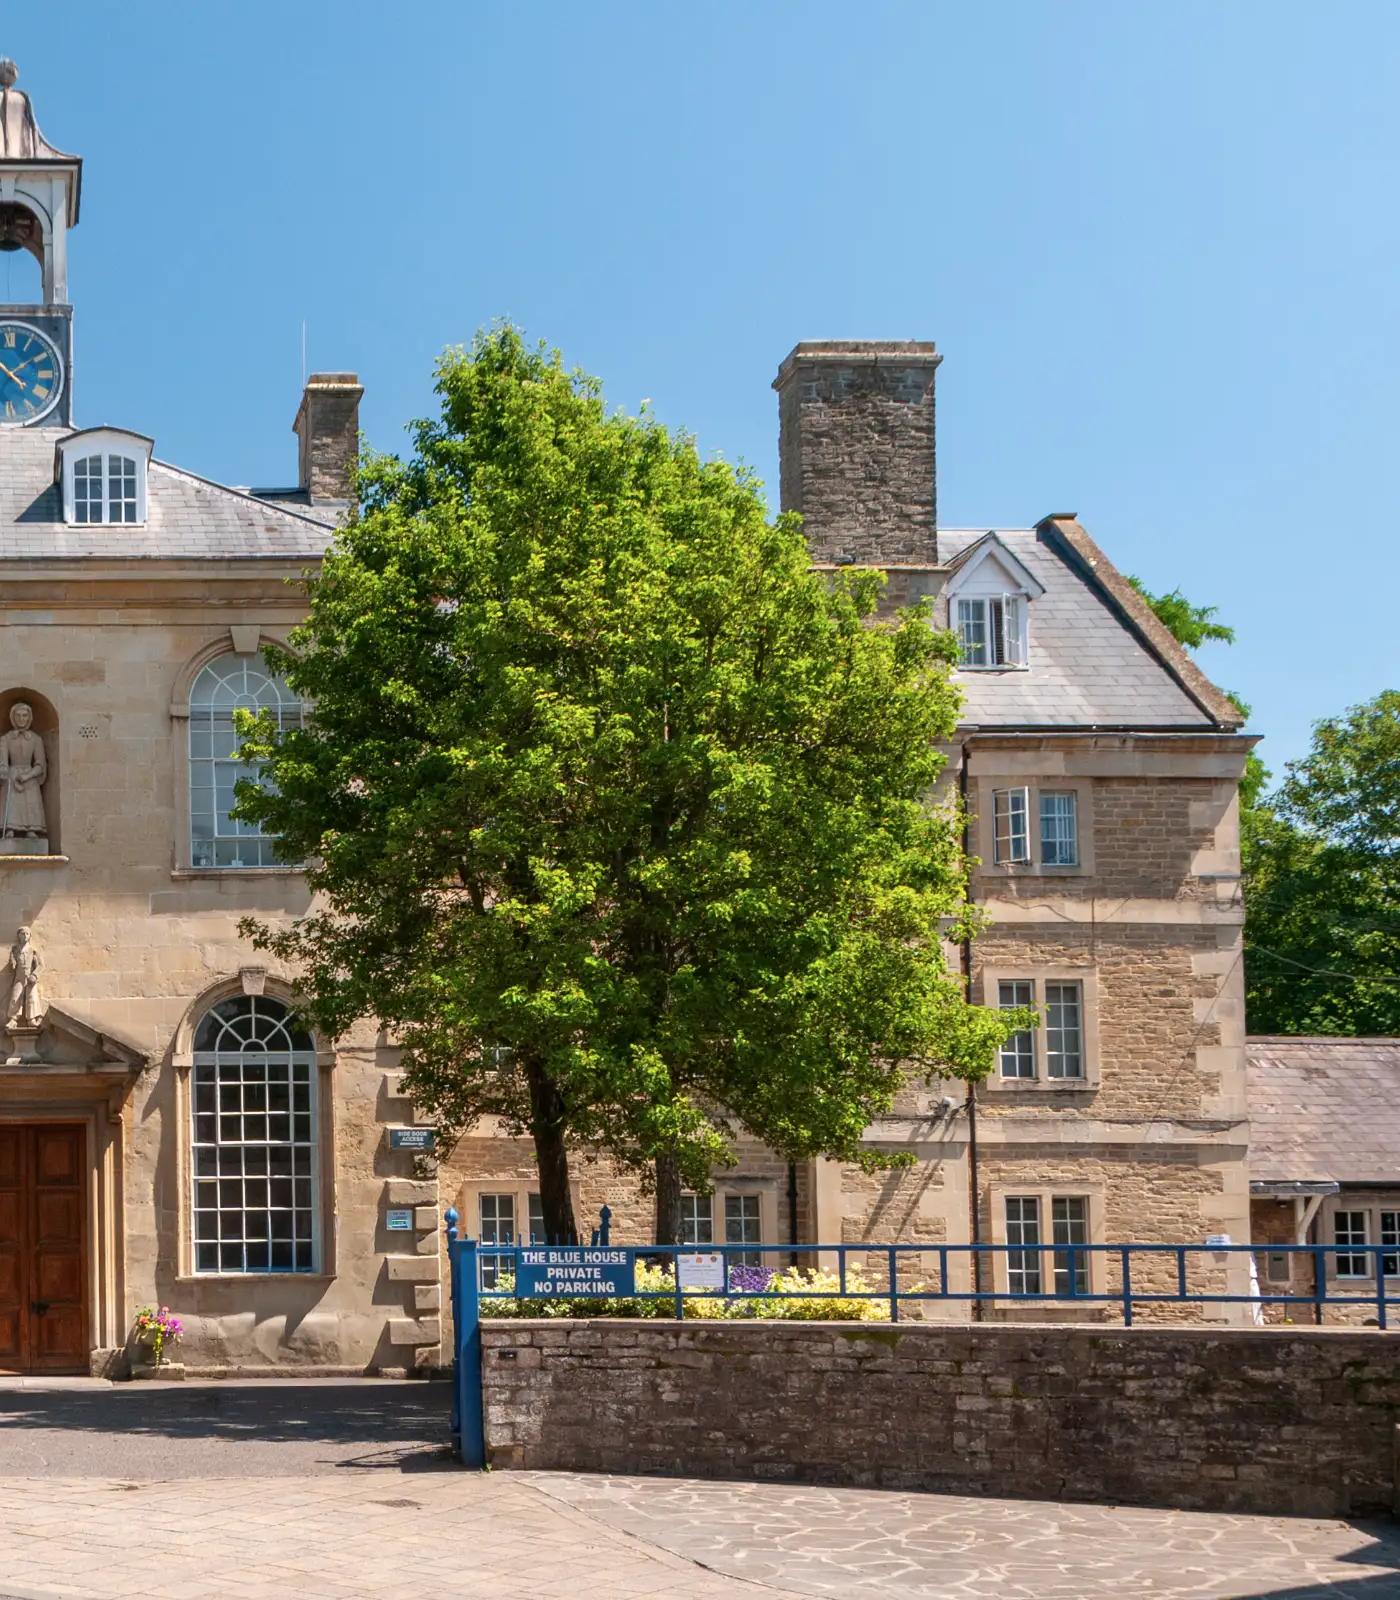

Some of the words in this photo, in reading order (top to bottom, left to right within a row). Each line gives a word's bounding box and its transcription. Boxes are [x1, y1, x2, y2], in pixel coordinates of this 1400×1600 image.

[522, 1251, 546, 1263] THE
[549, 1251, 581, 1263] BLUE
[585, 1251, 627, 1263] HOUSE
[547, 1268, 601, 1279] PRIVATE
[534, 1282, 552, 1293] NO
[556, 1282, 615, 1293] PARKING
